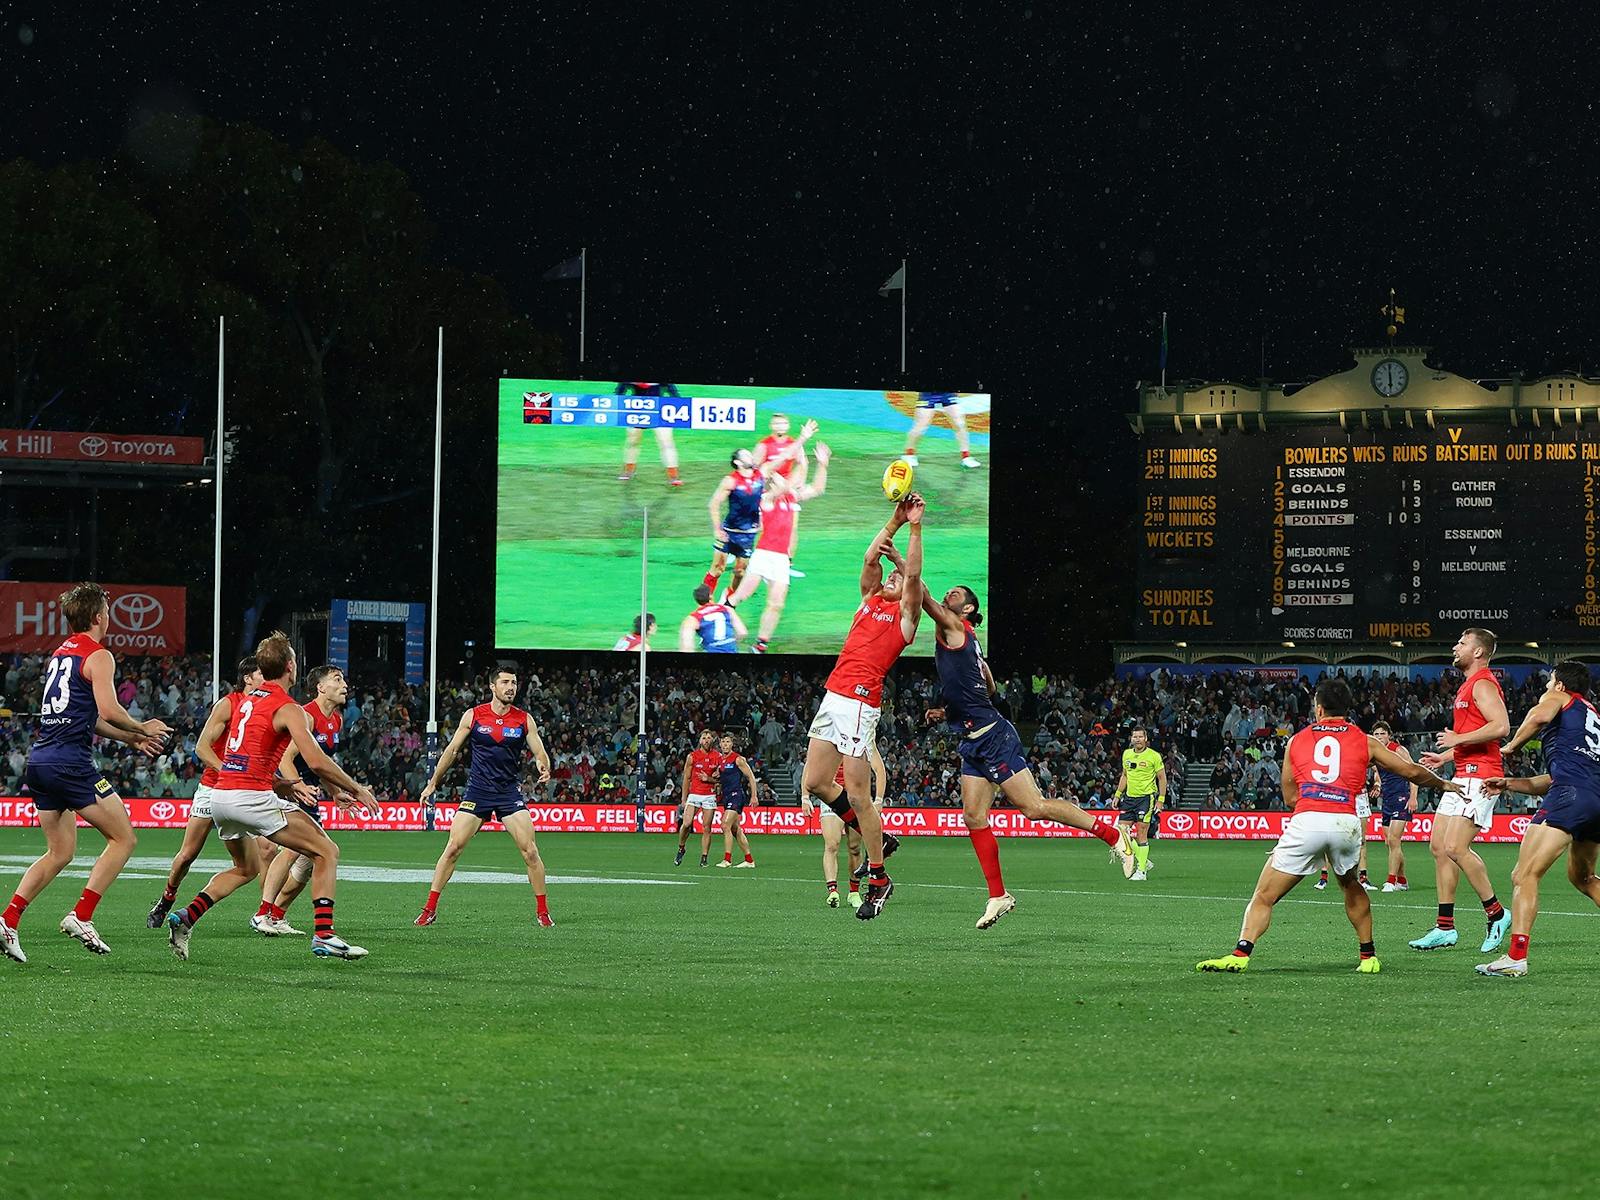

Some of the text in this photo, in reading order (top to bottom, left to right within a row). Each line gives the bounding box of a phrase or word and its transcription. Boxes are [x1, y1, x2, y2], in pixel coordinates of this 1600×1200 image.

[558, 396, 656, 410] 15 13 103
[561, 412, 575, 423] 9
[626, 414, 651, 426] 62
[661, 405, 690, 423] Q4
[699, 405, 746, 424] 15:46
[17, 436, 52, 454] Hill
[112, 441, 176, 456] TOYOTA
[1169, 448, 1218, 463] INNINGS
[1285, 447, 1348, 465] BOWLERS
[1352, 446, 1386, 463] WKTS
[1392, 445, 1428, 462] RUNS
[1435, 444, 1498, 462] BATSMEN
[1505, 444, 1531, 460] OUT
[1533, 443, 1543, 460] B
[1545, 443, 1577, 460] RUNS
[1169, 464, 1218, 479] INNINGS
[1276, 465, 1282, 480] 1
[1288, 466, 1345, 478] ESSENDON
[1273, 482, 1285, 496] 2
[1291, 483, 1346, 494] GOALS
[1452, 481, 1496, 491] GATHER
[1584, 477, 1594, 492] 2
[1168, 496, 1217, 510] INNINGS
[1274, 497, 1285, 512] 3
[1288, 498, 1349, 510] BEHINDS
[1456, 497, 1493, 507] ROUND
[1584, 493, 1595, 508] 3
[1168, 512, 1217, 527] INNINGS
[1273, 513, 1285, 528] 4
[1292, 515, 1345, 525] POINTS
[1584, 509, 1596, 524] 4
[1147, 532, 1214, 547] WICKETS
[1274, 530, 1285, 544] 5
[1444, 529, 1502, 540] ESSENDON
[1585, 525, 1595, 540] 5
[1273, 545, 1284, 560] 6
[1286, 547, 1351, 558] MELBOURNE
[1585, 542, 1595, 557] 6
[1273, 561, 1284, 576] 7
[1290, 560, 1421, 573] GOALS 9
[1441, 561, 1507, 572] MELBOURNE
[1585, 558, 1595, 573] 7
[1273, 577, 1284, 592] 8
[1287, 576, 1421, 589] BEHINDS 8
[1585, 574, 1595, 589] 8
[1143, 589, 1214, 607] SUNDRIES
[1272, 593, 1284, 607] 9
[1291, 595, 1343, 604] POINTS
[1585, 590, 1596, 605] 9
[347, 600, 410, 617] GATHER ROUND
[15, 601, 68, 636] Hil
[1149, 609, 1213, 625] TOTAL
[1283, 627, 1353, 639] SCORES CORRECT
[1369, 623, 1432, 638] UMPIRES
[106, 634, 167, 649] TOYOTA
[41, 656, 73, 714] 23
[228, 700, 253, 752] 3
[1311, 735, 1341, 784] 9
[16, 803, 40, 818] FO
[387, 807, 407, 821] 20
[410, 807, 455, 822] YAR
[529, 807, 585, 823] OYOTA
[749, 811, 805, 827] YEARS
[880, 812, 927, 827] YOTA
[937, 813, 1009, 829] FEENG
[1011, 814, 1027, 828] IT
[1198, 815, 1270, 830] TOYOTA
[1411, 818, 1432, 833] 20
